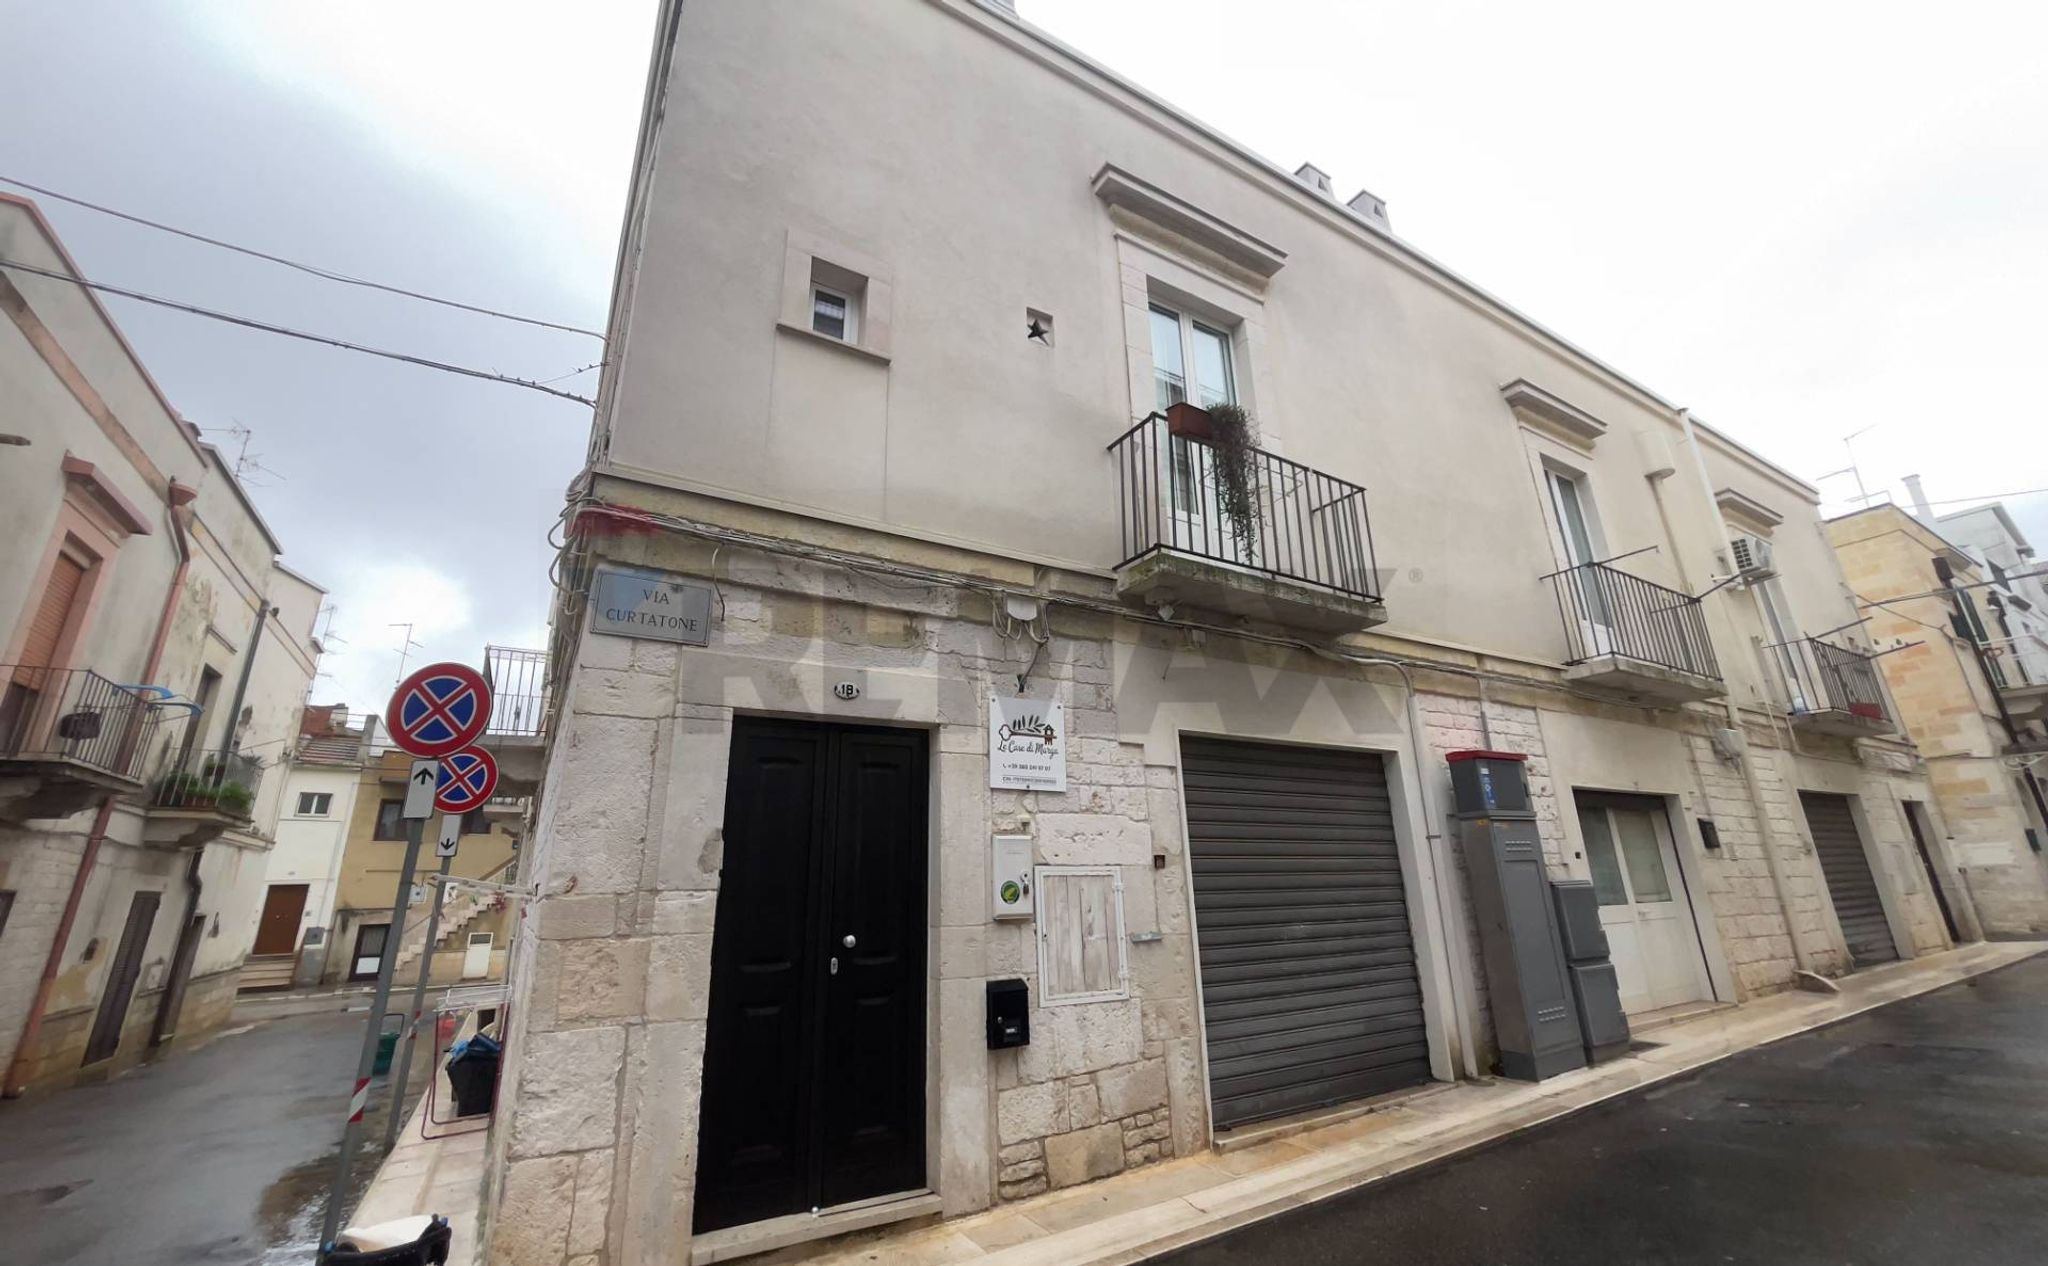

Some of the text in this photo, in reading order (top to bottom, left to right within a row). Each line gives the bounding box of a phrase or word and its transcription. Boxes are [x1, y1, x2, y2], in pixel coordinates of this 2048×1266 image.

[643, 588, 669, 605] VIA
[605, 607, 698, 632] CURTATONE
[1008, 740, 1025, 753] Case
[1026, 742, 1034, 752] di
